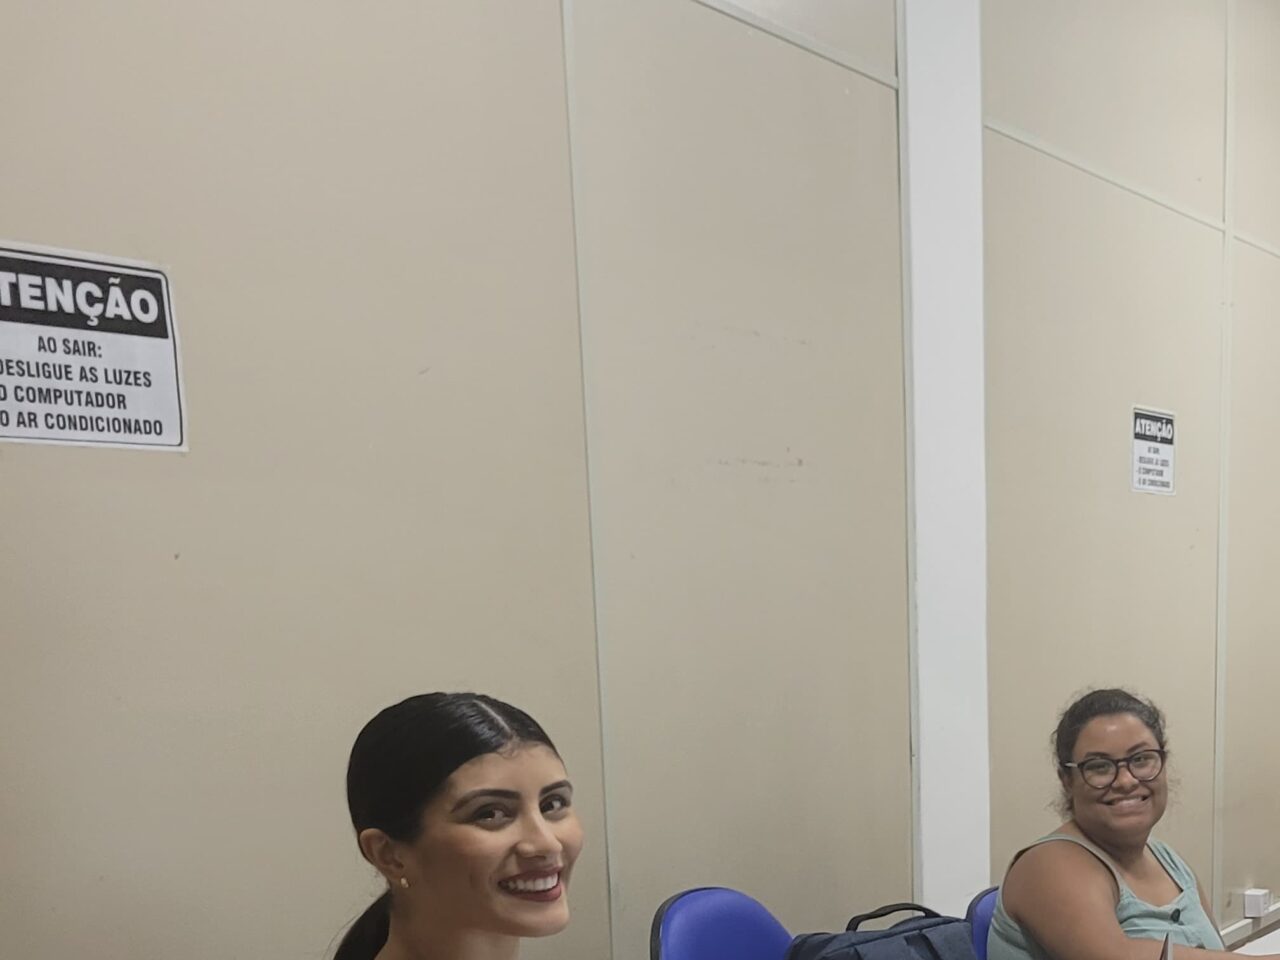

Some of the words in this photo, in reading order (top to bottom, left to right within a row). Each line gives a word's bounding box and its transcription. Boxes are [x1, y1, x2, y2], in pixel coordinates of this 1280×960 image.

[0, 271, 159, 326] TENÇÃO
[38, 336, 57, 353] AO
[63, 338, 102, 358] SAIR:
[79, 366, 98, 383] AS
[104, 368, 152, 387] LUZES
[14, 385, 127, 410] COMPUTADOR
[16, 411, 38, 428] AR
[44, 413, 163, 436] CONDICIONADO
[1135, 418, 1173, 441] ATENÇÃO
